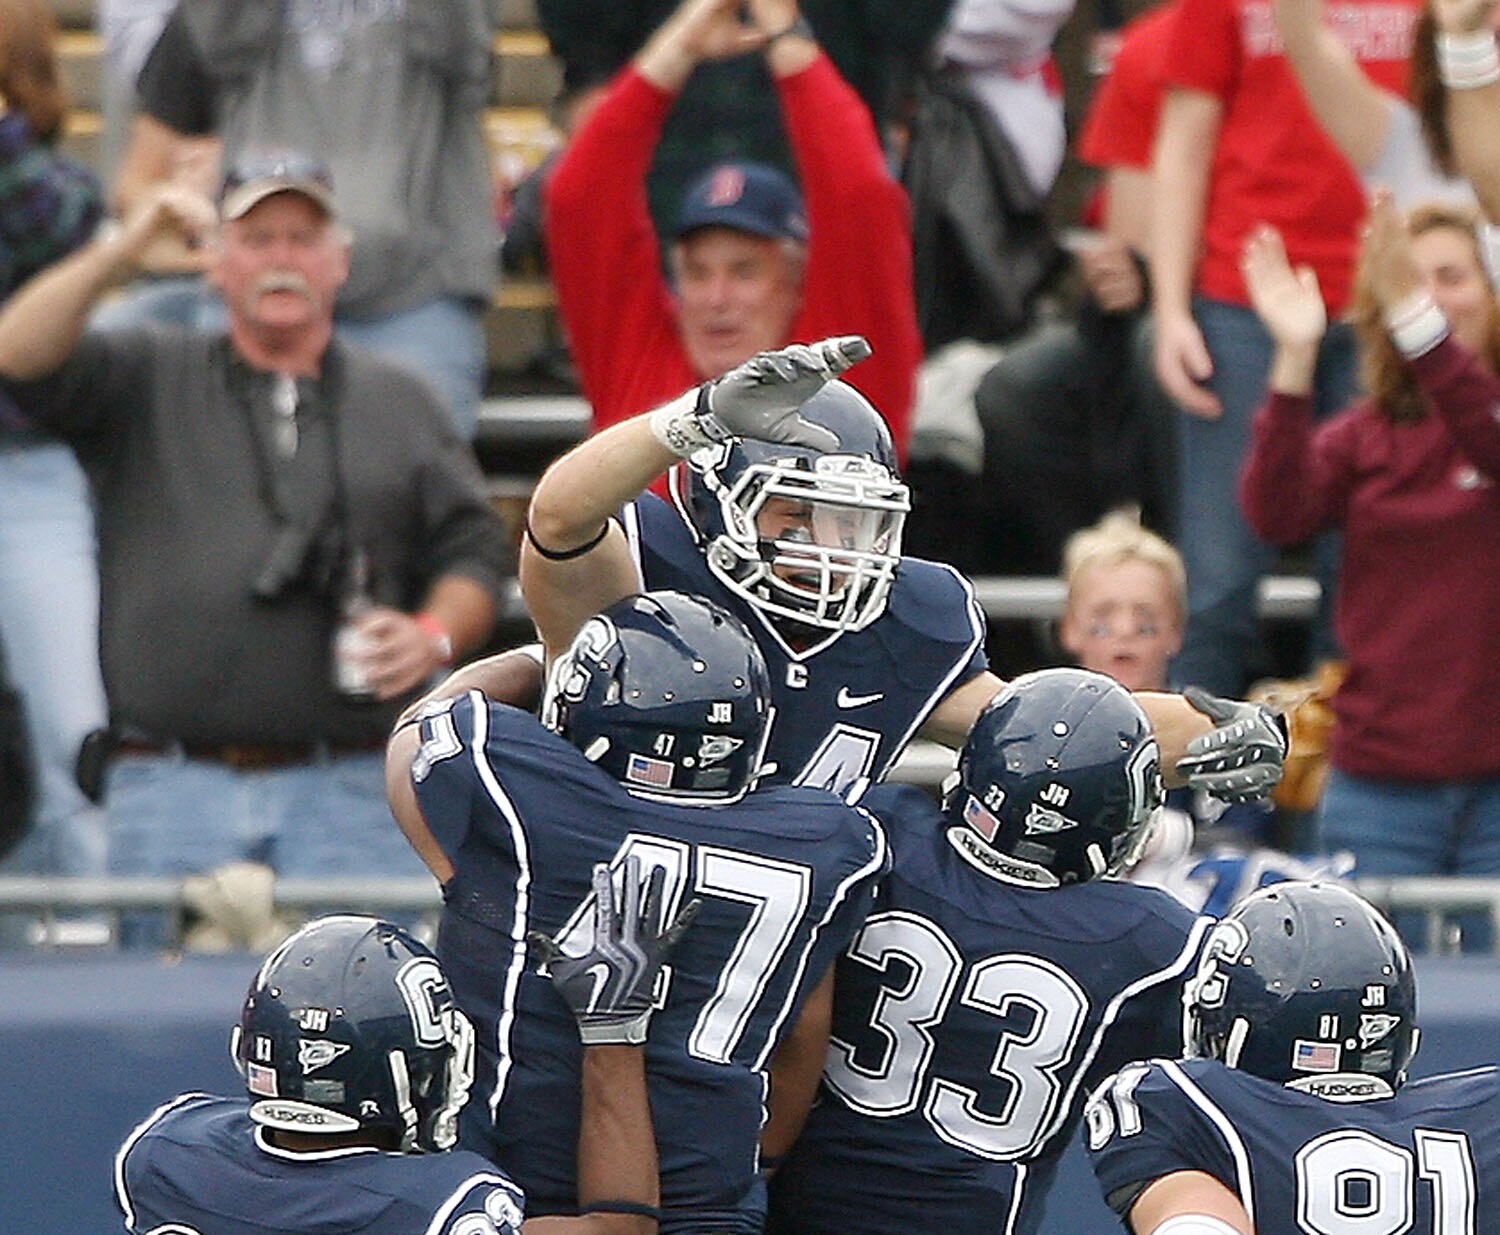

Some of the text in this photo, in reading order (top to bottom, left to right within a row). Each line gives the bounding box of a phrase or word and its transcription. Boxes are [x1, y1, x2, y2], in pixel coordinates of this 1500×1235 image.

[706, 703, 733, 724] JH
[983, 784, 1006, 812] 33
[1039, 783, 1071, 808] JH
[1361, 985, 1386, 1008] JH
[821, 909, 1091, 1163] 33
